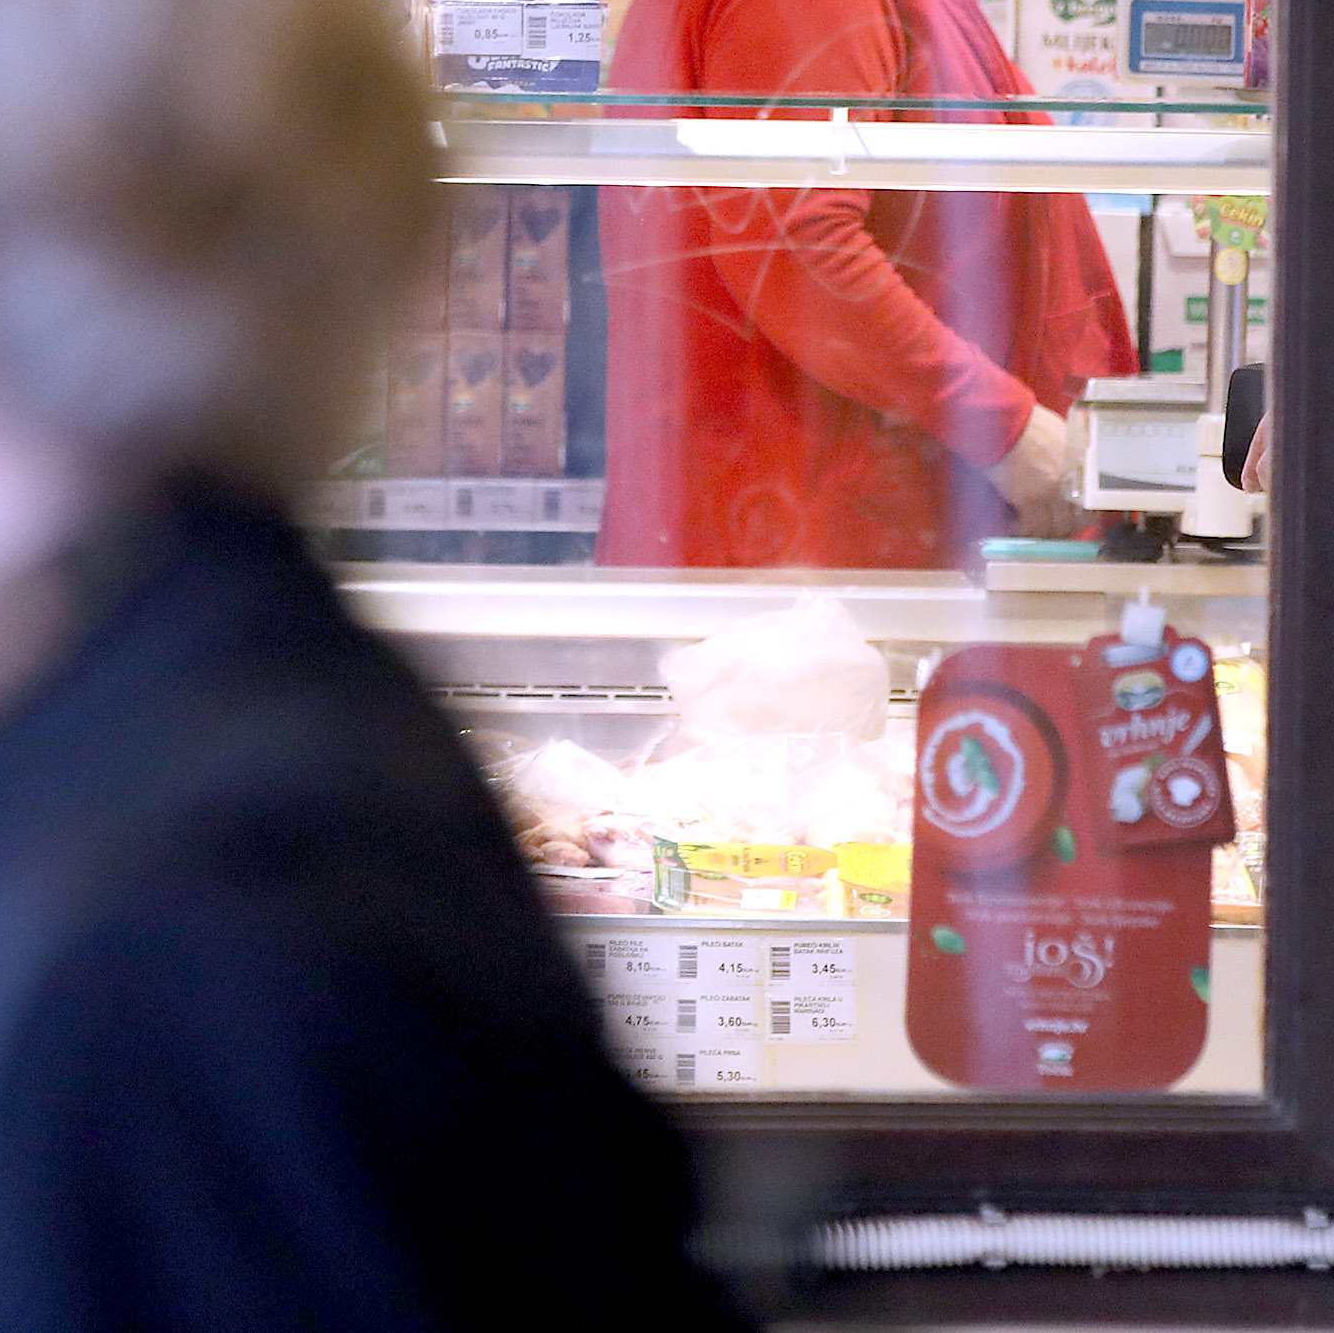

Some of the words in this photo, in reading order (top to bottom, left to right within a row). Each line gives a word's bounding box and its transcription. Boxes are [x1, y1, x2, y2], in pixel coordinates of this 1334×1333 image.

[474, 29, 498, 40] 0,85
[568, 32, 591, 44] 1,25
[487, 58, 550, 72] FANTASTIC
[1218, 200, 1266, 228] Cekin
[626, 962, 651, 973] 8,10
[718, 963, 743, 975] 4,15
[812, 963, 836, 975] 3,45
[625, 1015, 650, 1027] 4,75
[717, 1016, 742, 1029] 3,60
[812, 1017, 836, 1029] 6,30
[716, 1071, 741, 1083] 5,30
